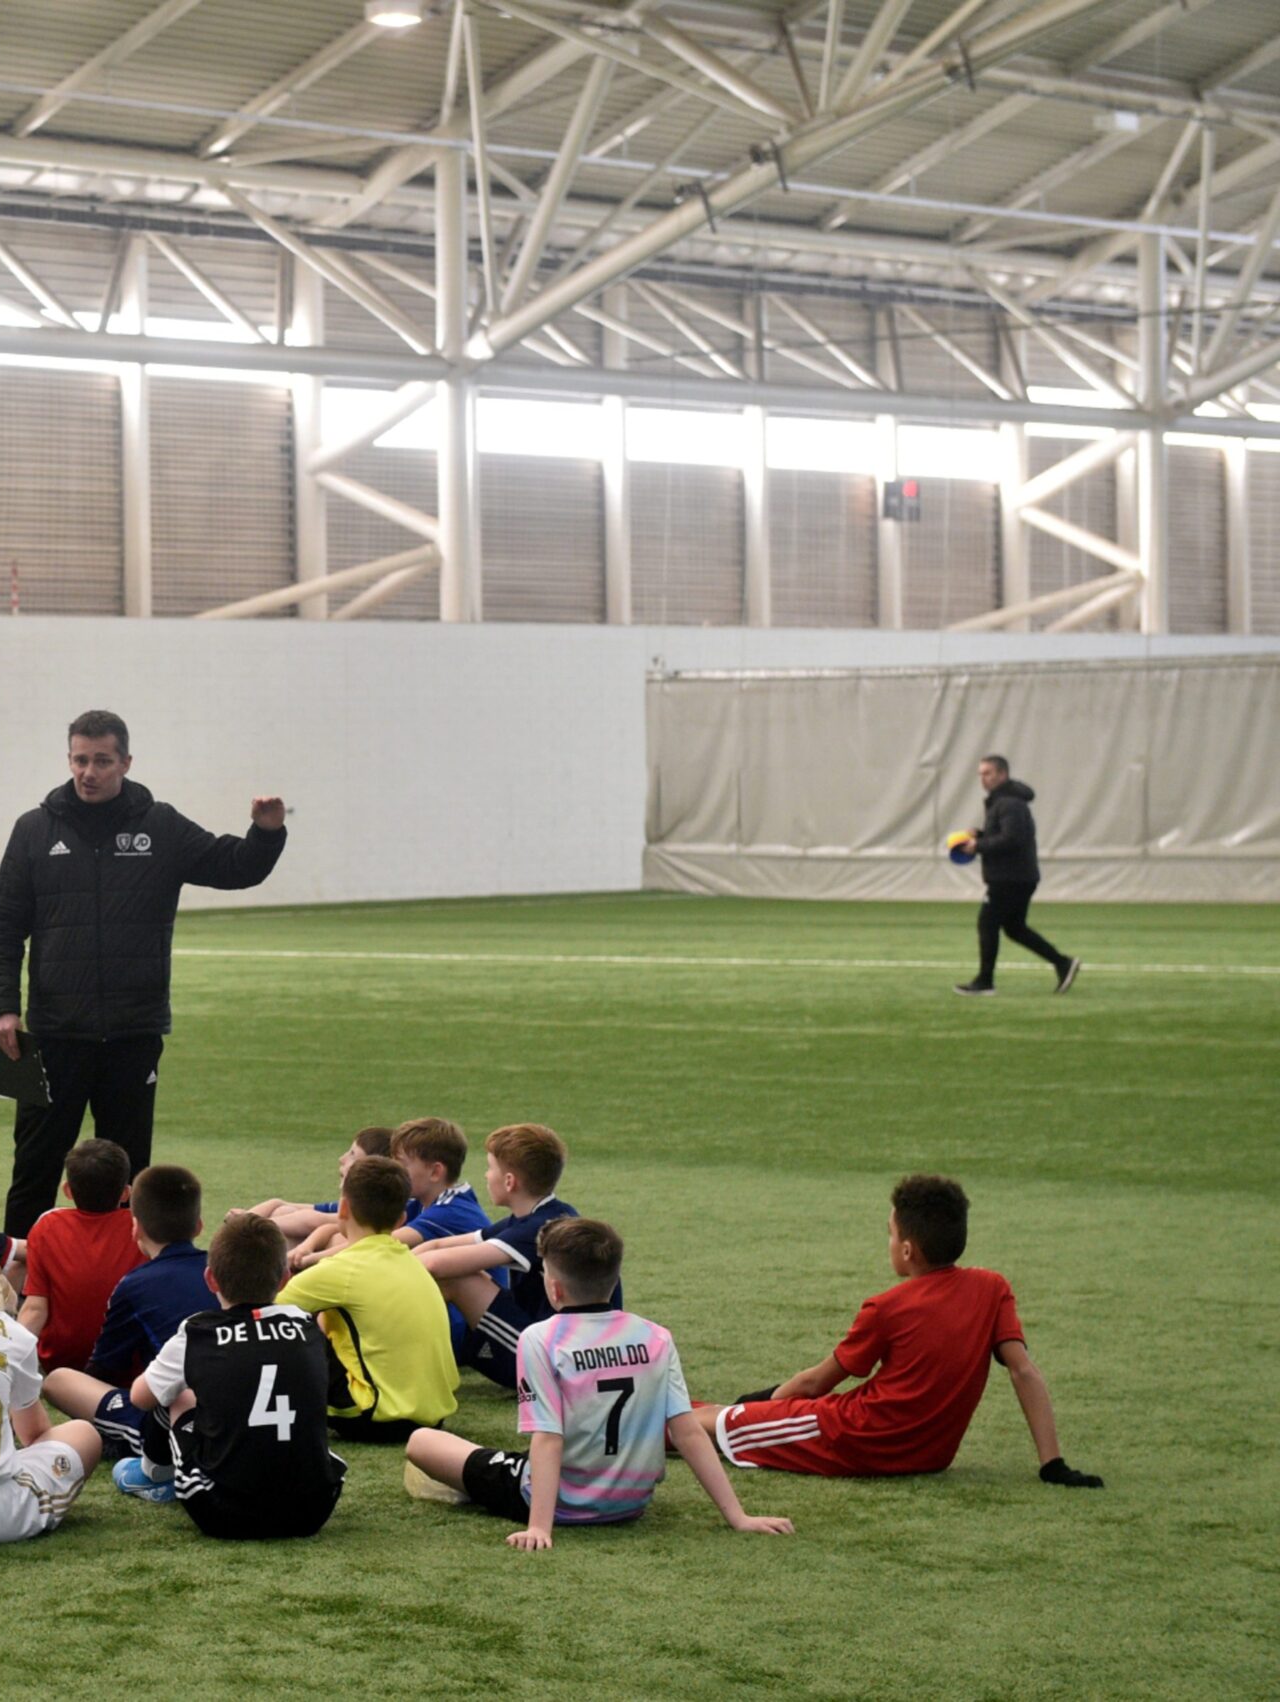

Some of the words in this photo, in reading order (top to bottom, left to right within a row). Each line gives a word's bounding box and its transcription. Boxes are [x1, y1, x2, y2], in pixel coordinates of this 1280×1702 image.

[215, 1322, 249, 1346] DE
[255, 1320, 308, 1342] LIGT
[572, 1343, 650, 1371] RONALDO
[248, 1364, 297, 1442] 4
[597, 1376, 635, 1456] 7
